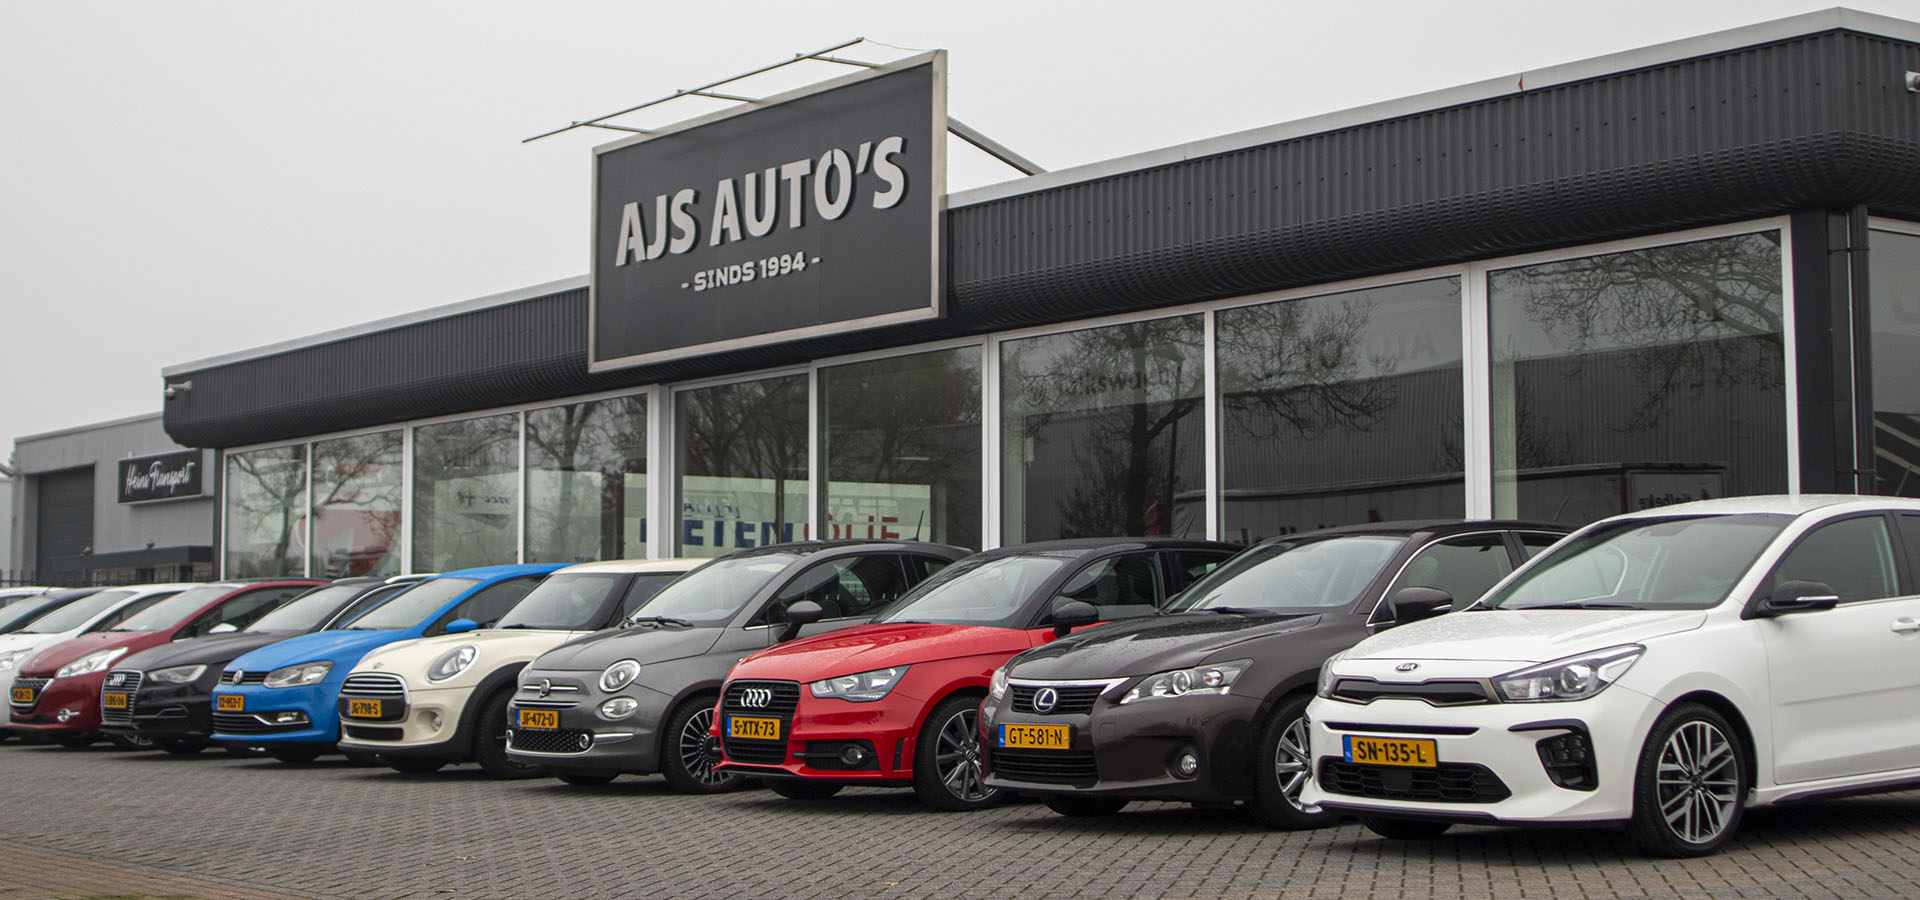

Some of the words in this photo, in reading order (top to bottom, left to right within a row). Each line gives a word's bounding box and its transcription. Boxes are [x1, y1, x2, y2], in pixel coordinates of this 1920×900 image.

[615, 188, 698, 267] AJS
[708, 135, 907, 247] AUTO'S
[693, 261, 757, 292] SINDS
[759, 251, 806, 279] 1994
[522, 712, 555, 726] JF-472-D
[734, 720, 775, 736] 5-XTX-73
[1009, 728, 1062, 745] GT-581-N
[1356, 740, 1428, 764] SN-135-L
